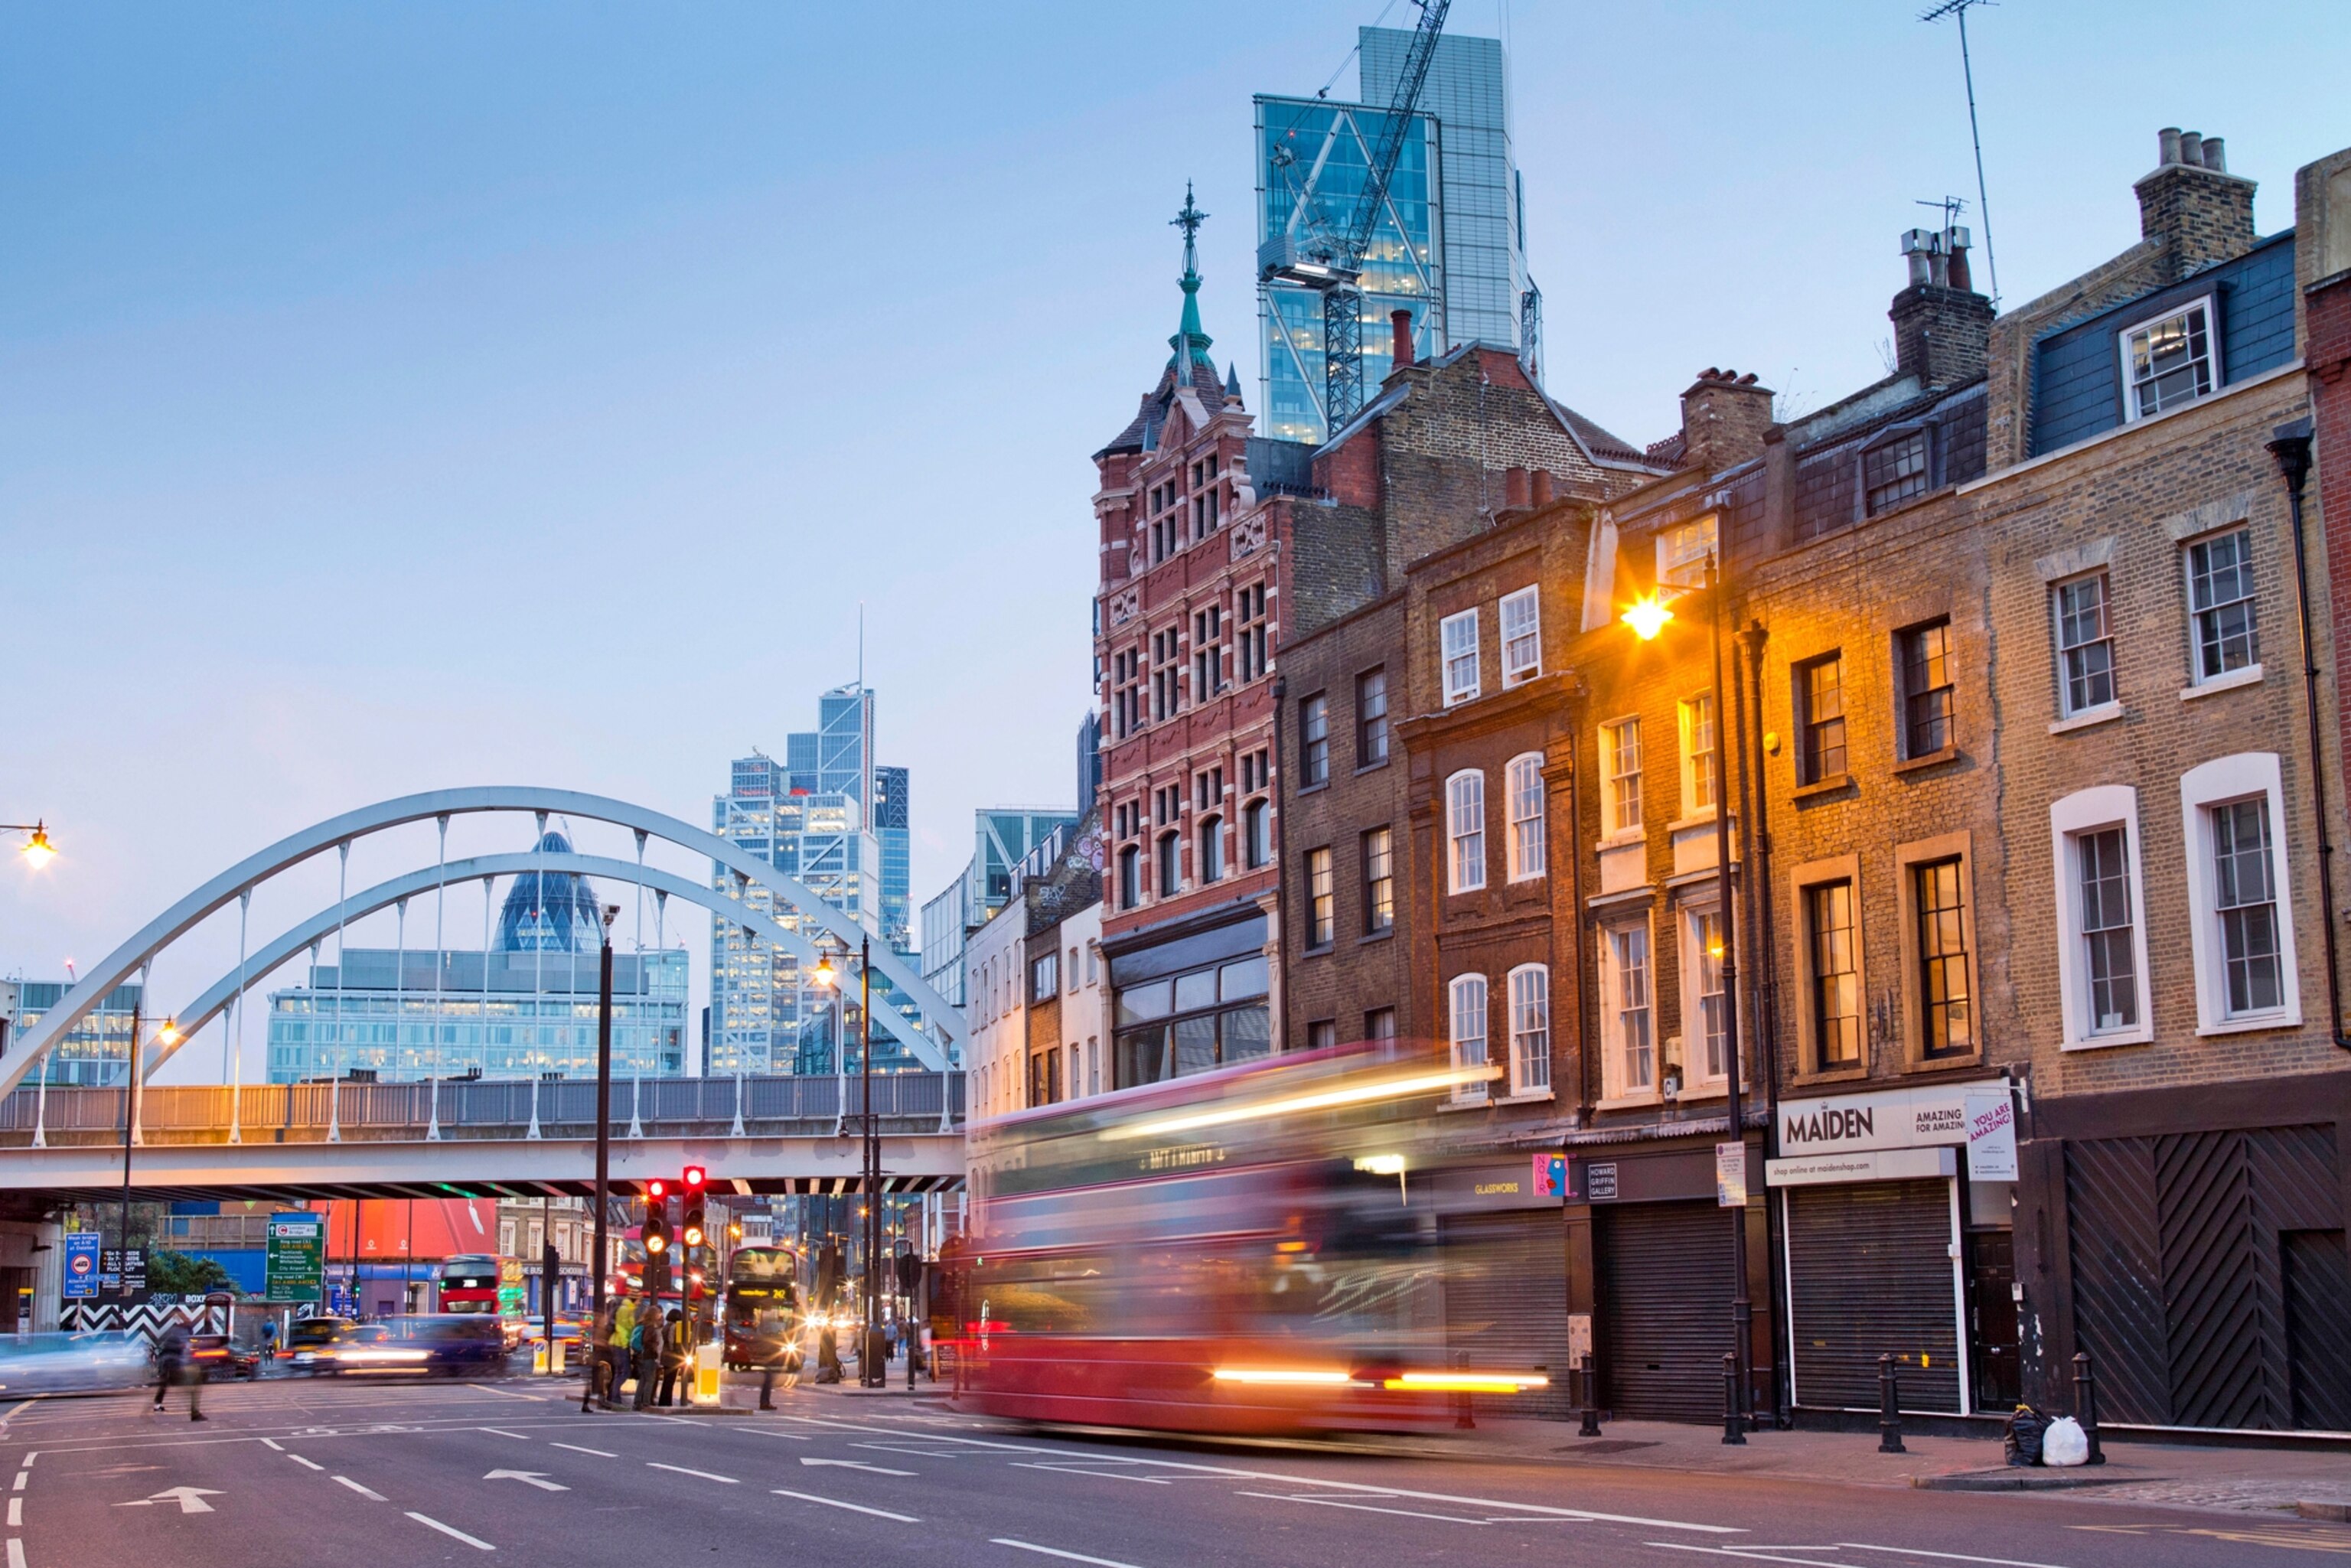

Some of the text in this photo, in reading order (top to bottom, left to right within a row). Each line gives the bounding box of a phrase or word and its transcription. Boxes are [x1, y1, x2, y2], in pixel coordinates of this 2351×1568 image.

[1916, 1109, 1961, 1123] AMAZING
[1973, 1102, 2010, 1127] YOU ARE
[1786, 1107, 1873, 1144] MAIDEN
[1916, 1123, 1931, 1133] FOR
[1969, 1113, 2012, 1143] AMAZING!
[1537, 1156, 1546, 1193] NOIR
[1590, 1167, 1615, 1175] HOWARD
[1773, 1168, 1788, 1176] shop
[1789, 1165, 1808, 1174] online
[1817, 1162, 1870, 1172] maidenshop.com
[1590, 1177, 1615, 1185] GRIFFIN
[1475, 1182, 1519, 1195] GLASSWORKS
[1591, 1187, 1615, 1195] GALLERY
[772, 1289, 786, 1299] 242
